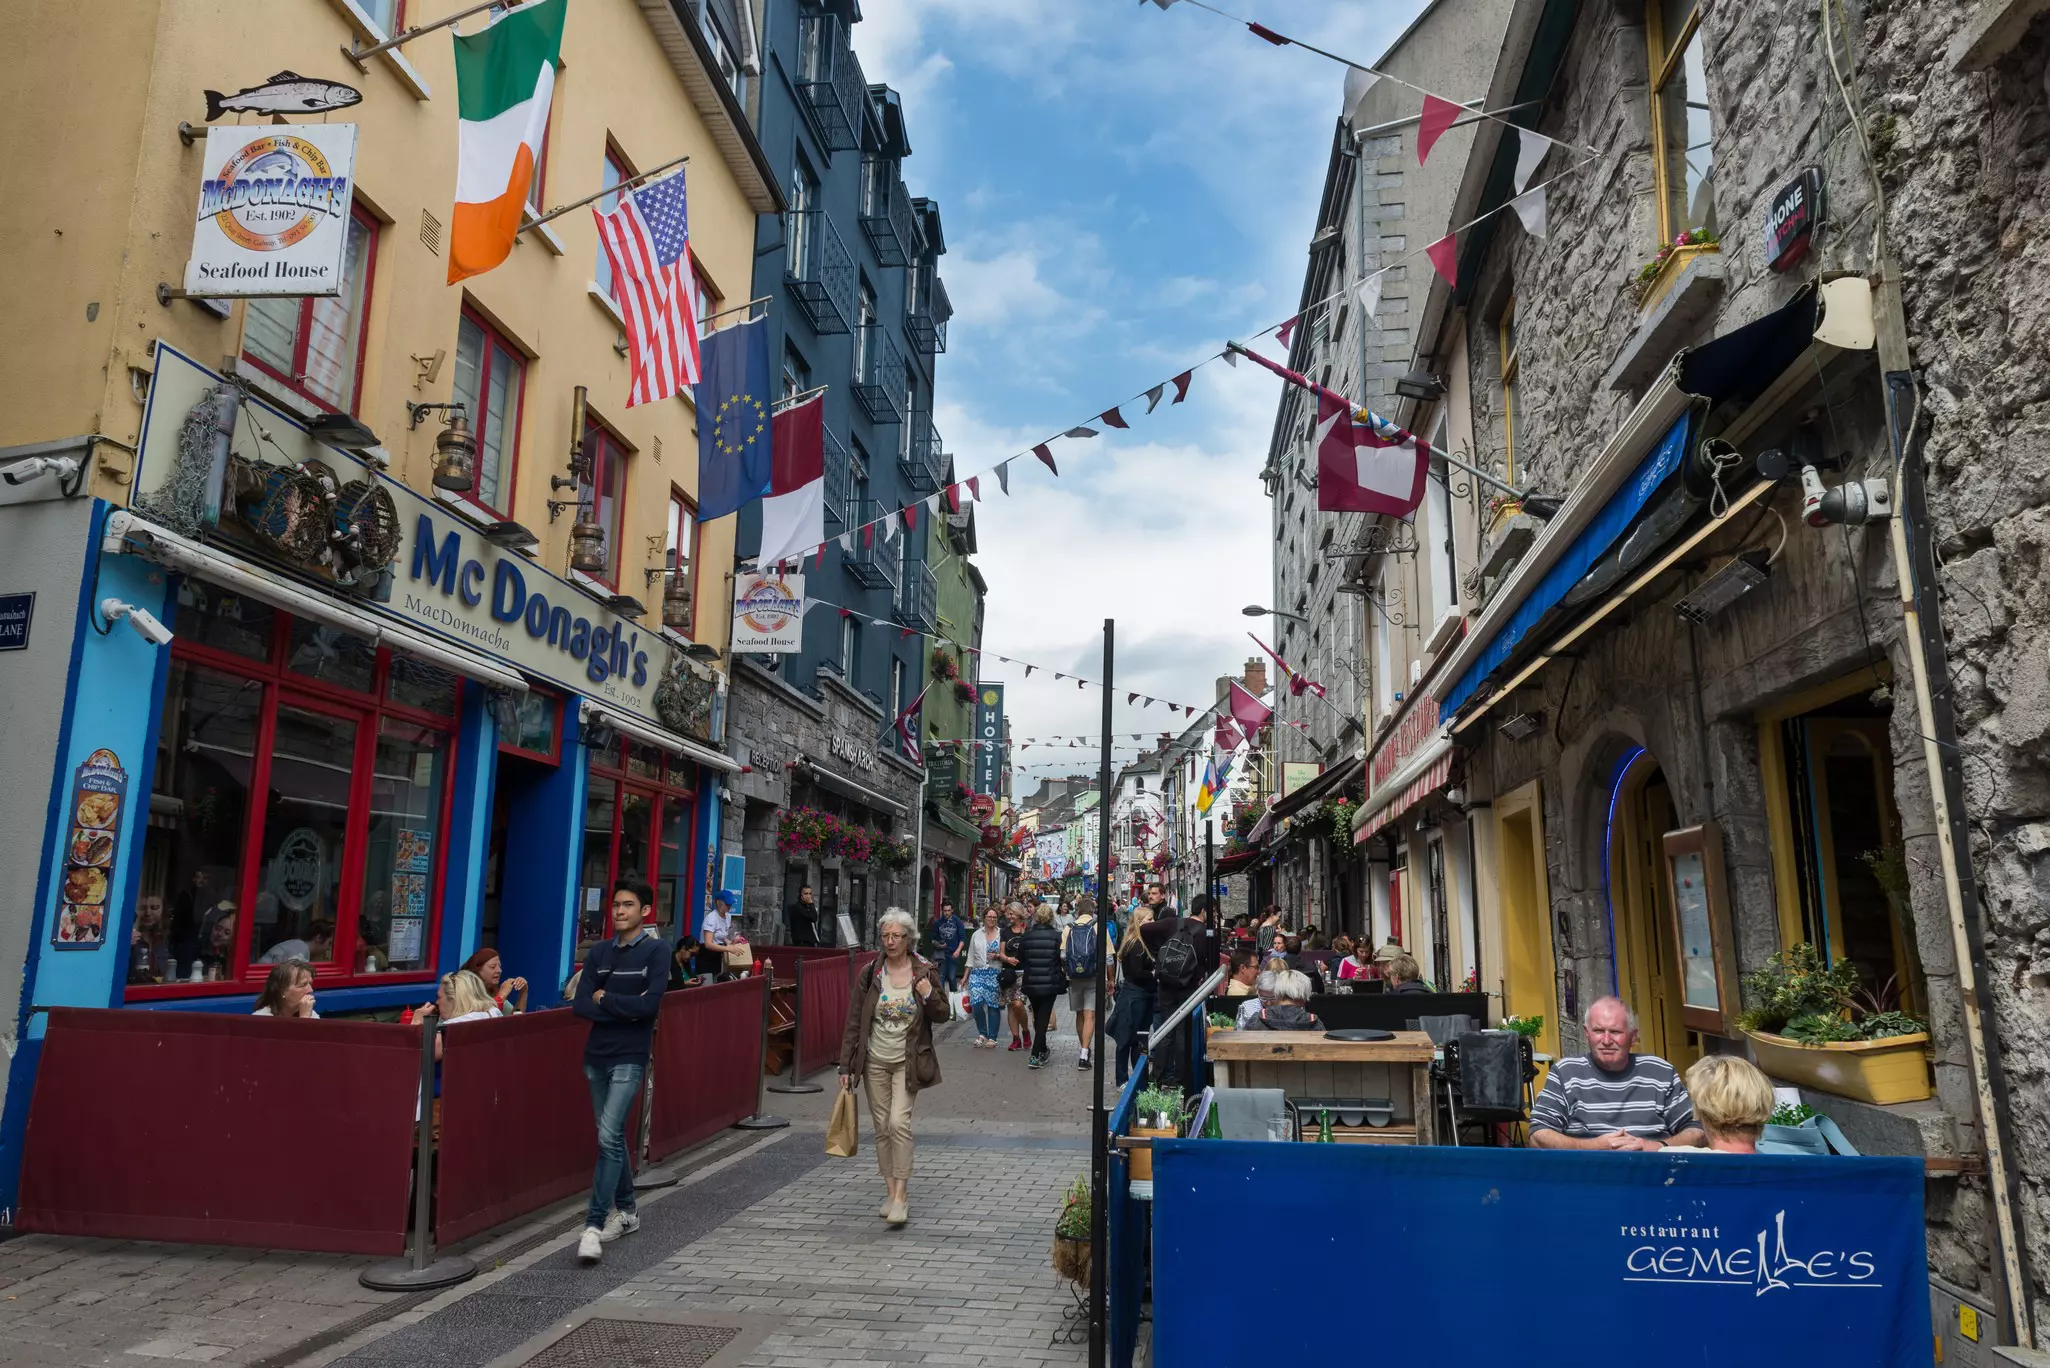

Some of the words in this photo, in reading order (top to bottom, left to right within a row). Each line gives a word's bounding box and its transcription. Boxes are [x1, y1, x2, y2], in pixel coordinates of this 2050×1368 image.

[222, 149, 250, 178] Seafood
[251, 143, 265, 156] Bar
[273, 139, 291, 148] Fish
[301, 145, 319, 163] Chip
[316, 159, 327, 175] Bar
[246, 210, 268, 221] Est.
[270, 209, 296, 221] 1902
[1765, 185, 1803, 242] PHONE
[199, 262, 270, 280] Seafood
[274, 261, 329, 279] House
[404, 594, 511, 651] MacDonnacha
[736, 637, 769, 646] Seafood
[771, 637, 796, 646] House
[604, 683, 620, 699] Est.
[621, 691, 641, 709] 1902
[750, 749, 783, 774] RECEPTION
[984, 711, 996, 796] HOSTEL
[1621, 1224, 1720, 1239] restaurant
[1626, 1210, 1876, 1297] GEMELLE'S
